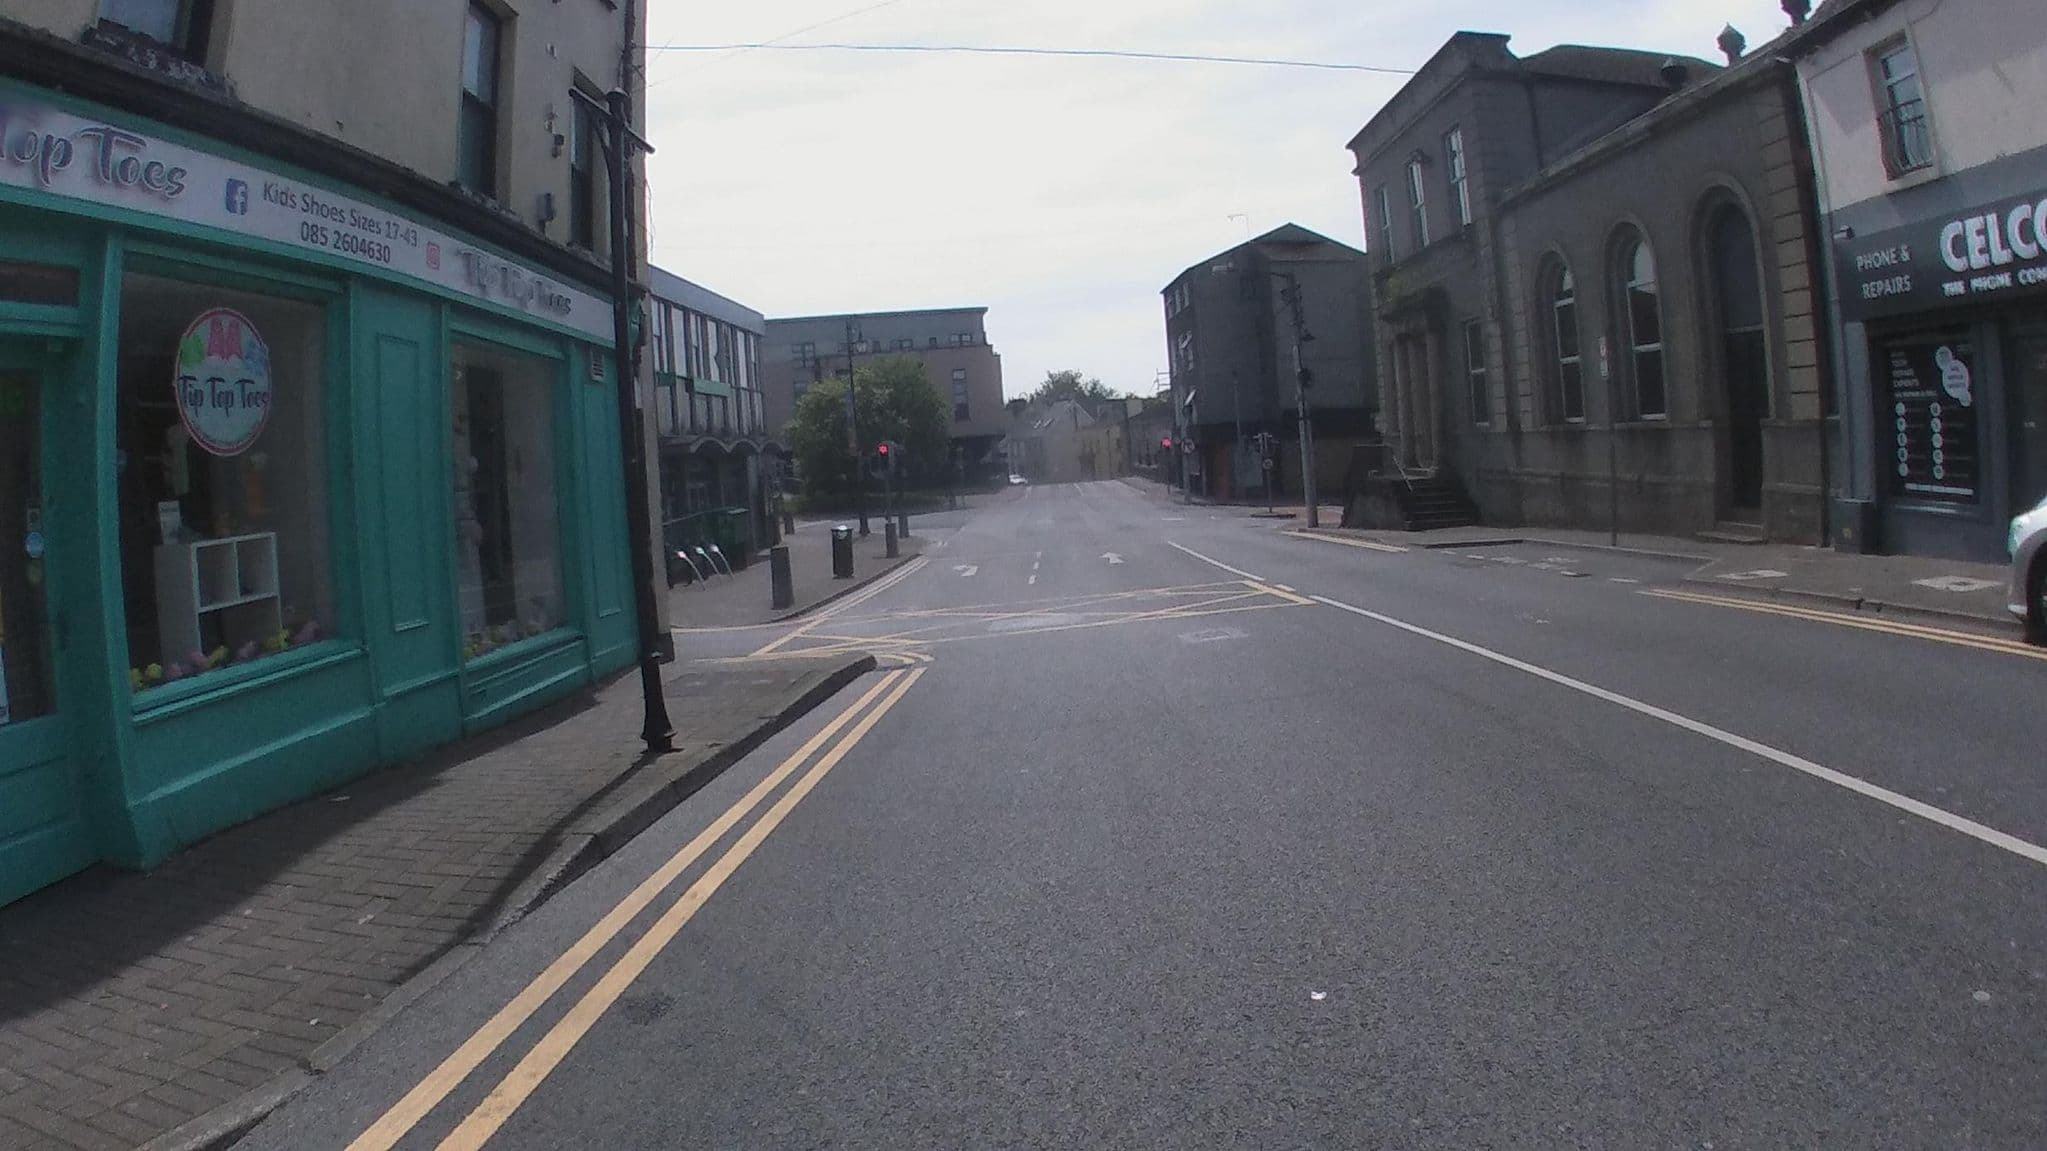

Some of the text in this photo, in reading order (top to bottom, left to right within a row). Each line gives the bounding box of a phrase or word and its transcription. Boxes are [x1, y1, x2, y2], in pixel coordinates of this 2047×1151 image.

[79, 124, 188, 197] Toes
[263, 182, 417, 247] Kids Shoes Sizes 17-43
[301, 221, 391, 263] 085 2604630
[1856, 244, 1911, 272] PHONE &
[1862, 273, 1912, 299] REPAIRS
[1942, 280, 1966, 297] THE
[1970, 272, 2012, 292] PHONE
[178, 375, 203, 418] Tip
[206, 377, 234, 418] Top
